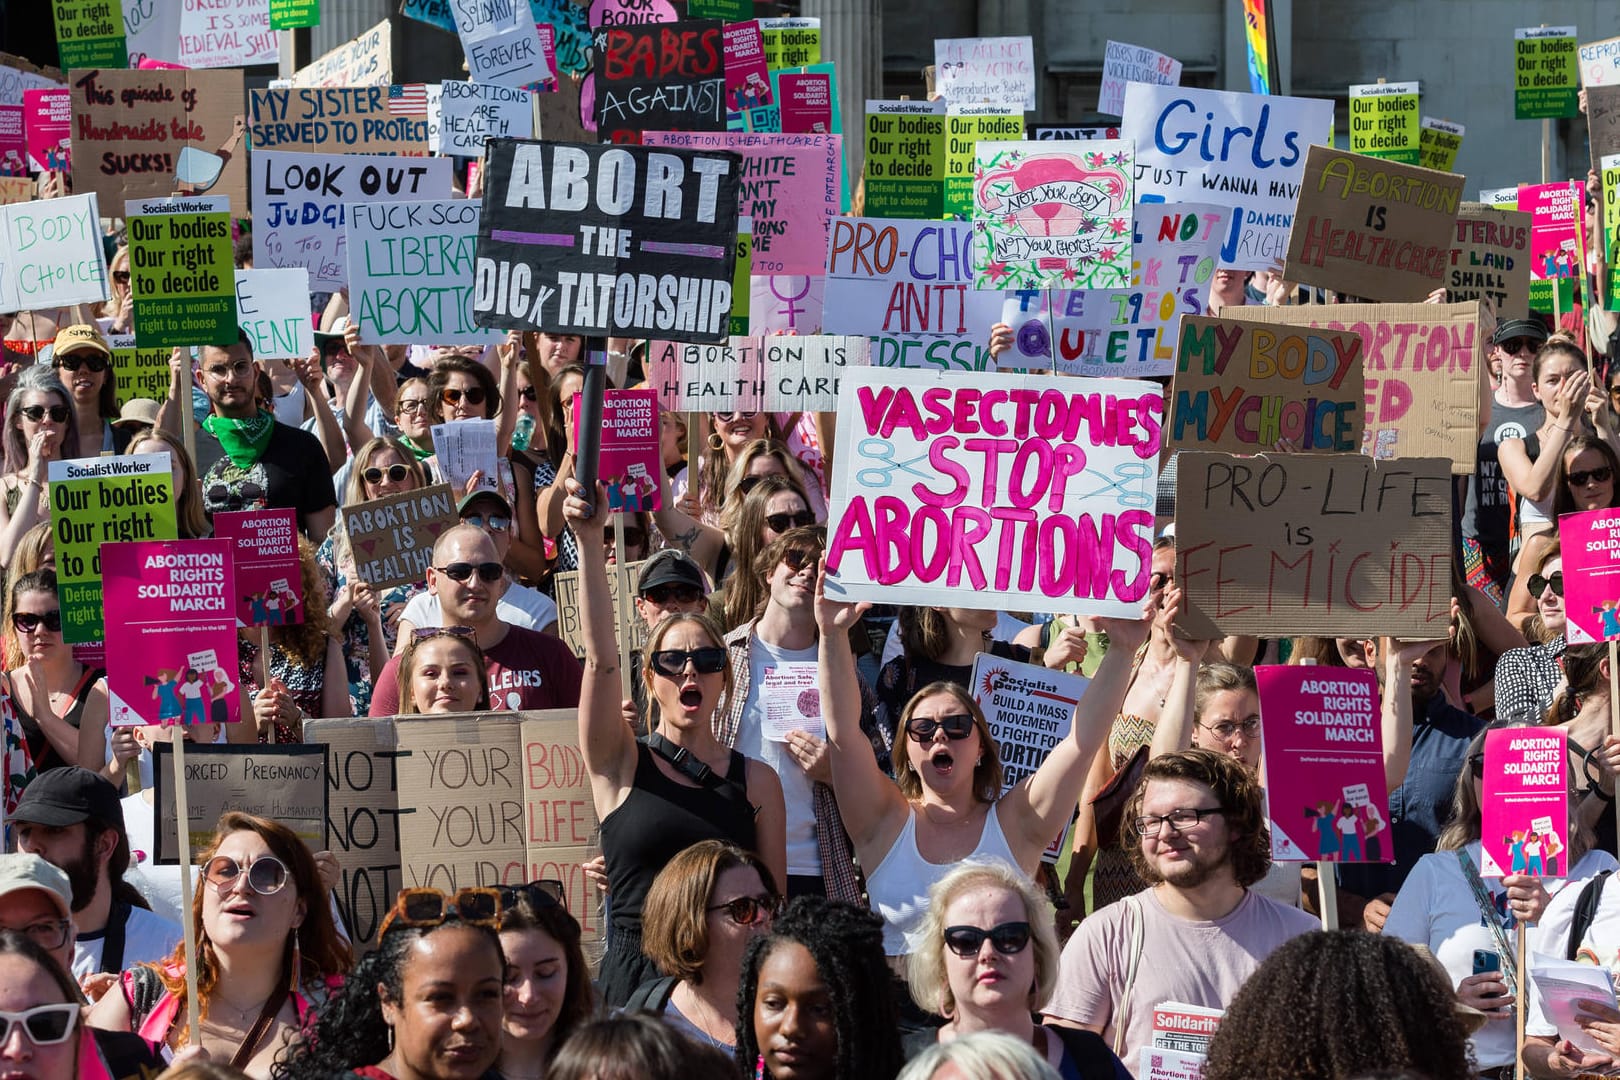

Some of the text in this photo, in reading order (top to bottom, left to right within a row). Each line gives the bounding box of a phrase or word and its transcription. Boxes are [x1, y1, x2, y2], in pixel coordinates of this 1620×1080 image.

[77, 21, 114, 37] decide
[733, 34, 757, 44] RIGHTS
[781, 29, 818, 46] bodies
[472, 37, 536, 73] FOREVER
[604, 28, 719, 79] BABES
[735, 47, 760, 58] MARCH
[781, 47, 809, 63] right
[1541, 39, 1574, 53] bodies
[1534, 72, 1568, 86] decide
[76, 70, 197, 112] This episode of
[442, 82, 529, 103] ABORTIONS
[251, 87, 384, 121] MY SISTER
[470, 105, 502, 119] ARE
[601, 78, 725, 126] AGAINST
[1377, 97, 1415, 112] bodies
[171, 117, 205, 141] tale
[252, 117, 428, 147] SERVED TO PROTECT
[444, 115, 509, 134] HEALTH
[869, 116, 942, 135] Our bodies
[978, 117, 1020, 135] bodies
[1155, 99, 1300, 169] Girls
[663, 134, 720, 146] ABORTION
[738, 135, 822, 147] HEALTHCARE
[869, 138, 931, 160] Our right
[1370, 133, 1408, 148] decide
[100, 152, 174, 175] SUCKS!
[869, 159, 933, 176] to decide
[265, 159, 427, 198] LOOK OUT
[505, 143, 730, 224] ABORT
[1135, 164, 1258, 195] JUST WANNA
[1318, 157, 1461, 216] ABORTION
[751, 199, 777, 218] MY
[1005, 188, 1038, 214] NOT
[1039, 185, 1068, 203] YOUR
[352, 205, 421, 230] FUCK
[1158, 213, 1221, 242] NOT
[1366, 205, 1387, 232] IS
[14, 210, 90, 252] BODY
[132, 216, 227, 242] Our bodies
[580, 225, 632, 259] THE
[1024, 237, 1056, 260] YOUR
[1301, 215, 1448, 279] HEALTHCARE
[134, 244, 216, 271] Our right
[1470, 252, 1514, 271] LAND
[20, 257, 105, 294] CHOICE
[1177, 254, 1215, 284] TO
[1451, 270, 1506, 289] SHALL
[136, 270, 220, 295] to decide
[139, 300, 229, 316] Defend woman's
[882, 281, 967, 334] ANTI
[1015, 286, 1202, 325] THE 1950'S
[140, 318, 217, 334] right to choose
[660, 343, 803, 364] ABORTION
[825, 347, 847, 366] IS
[1177, 323, 1361, 390] MY BODY
[137, 371, 171, 392] right
[663, 380, 766, 397] HEALTH
[616, 408, 652, 418] RIGHTS
[857, 386, 1164, 459] VASECTOMIES
[616, 428, 652, 437] MARCH
[912, 435, 1087, 513] STOP
[1481, 461, 1497, 477] MY
[56, 479, 168, 511] Our bodies
[1482, 492, 1495, 506] MY
[242, 517, 290, 529] ABORTION
[348, 493, 451, 537] ABORTION
[58, 512, 155, 544] Our right
[257, 526, 291, 537] RIGHTS
[392, 526, 416, 551] IS
[1284, 522, 1314, 546] is
[238, 536, 292, 548] SOLIDARITY
[258, 545, 293, 555] MARCH
[824, 495, 1156, 604] ABORTIONS
[61, 552, 84, 577] to
[144, 553, 223, 569] ABORTION
[170, 568, 224, 583] RIGHTS
[138, 582, 225, 599] SOLIDARITY
[170, 597, 225, 612] MARCH
[67, 607, 96, 625] right
[489, 669, 542, 692] LEURS
[999, 670, 1059, 693] Socialist
[1300, 680, 1371, 696] ABORTION
[993, 694, 1069, 721] BUILD A MASS
[1323, 697, 1372, 711] RIGHTS
[996, 710, 1060, 733] MOVEMENT
[1295, 711, 1373, 727] SOLIDARITY
[1002, 727, 1040, 745] FIGHT
[1325, 727, 1374, 742] MARCH
[1509, 738, 1560, 751] ABORTION
[1523, 750, 1560, 762] RIGHTS
[184, 758, 320, 781] ORCED PREGNANCY
[328, 750, 412, 792] NOT
[423, 747, 513, 789] YOUR
[1503, 762, 1560, 775] SOLIDARITY
[1522, 774, 1560, 786] MARCH
[272, 802, 324, 818] HUMANITY
[328, 800, 587, 852] NOT YOUR LIFE
[1156, 1039, 1190, 1050] GET THE
[1151, 1068, 1187, 1079] Abortion:
